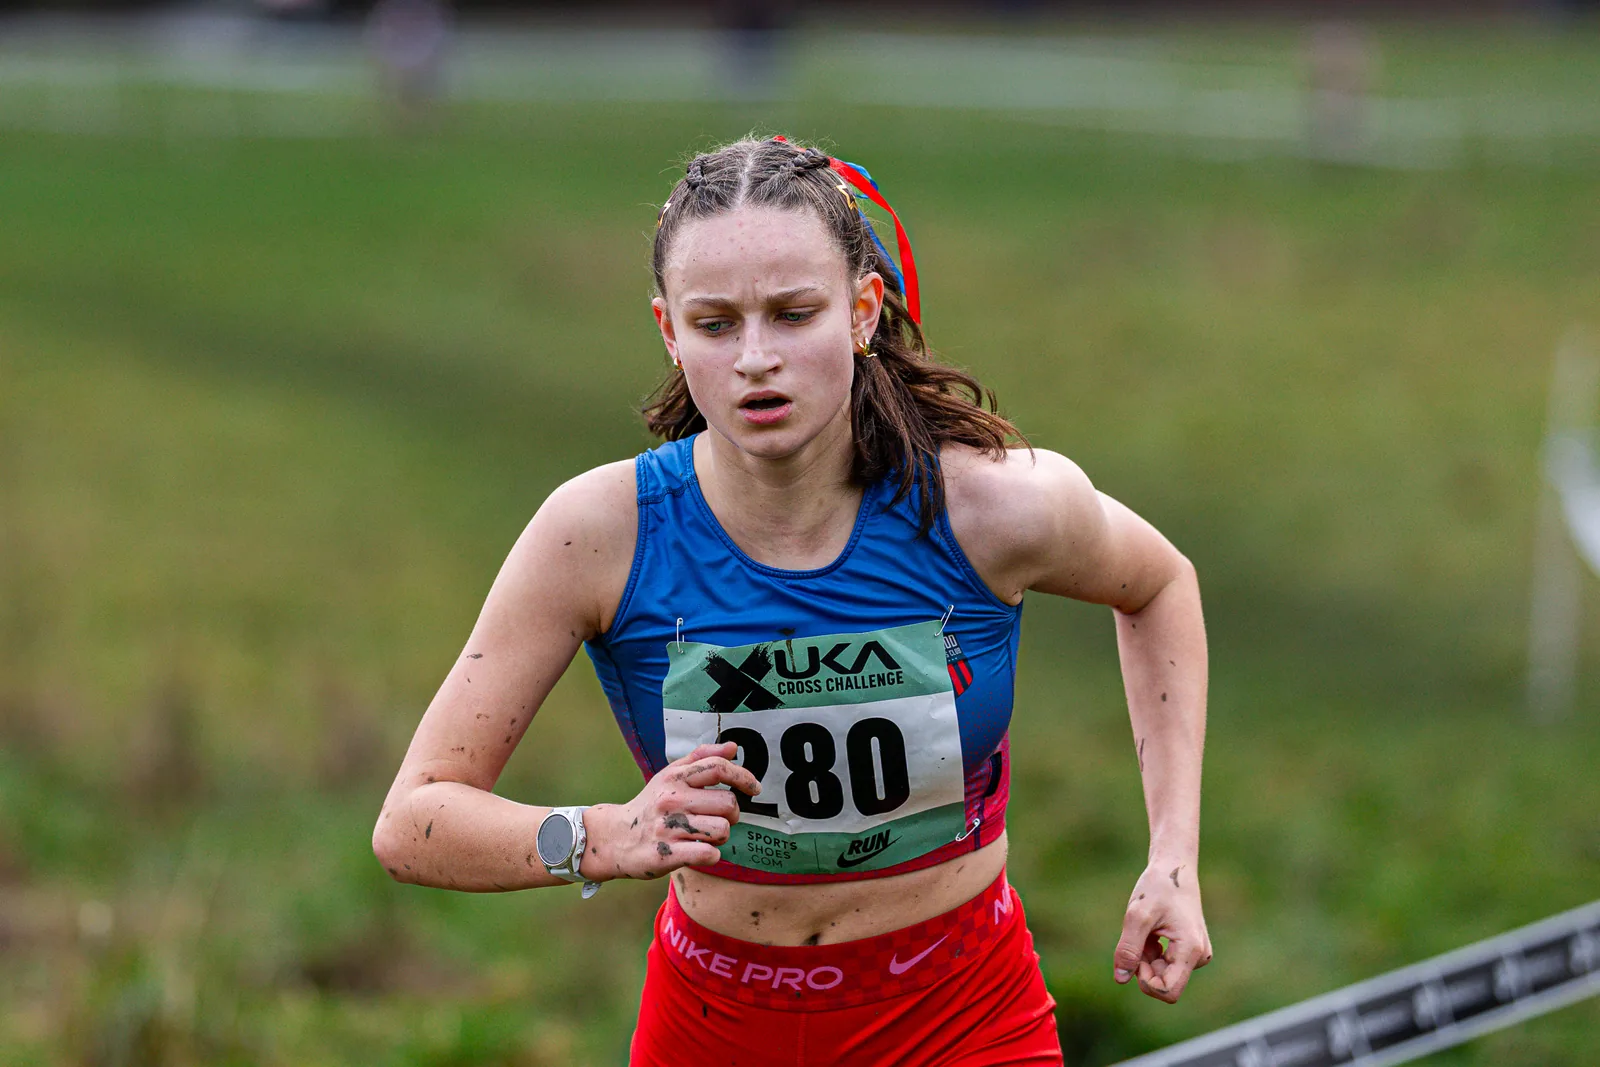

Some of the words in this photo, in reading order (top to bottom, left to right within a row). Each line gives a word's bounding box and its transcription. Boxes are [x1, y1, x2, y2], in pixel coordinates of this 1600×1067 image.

[774, 640, 902, 680] UKA
[777, 679, 822, 696] CROSS
[825, 670, 904, 693] CHALLENGE
[714, 716, 911, 820] 280
[747, 830, 798, 850] SPORTS
[747, 842, 791, 860] SHOES
[847, 829, 891, 856] RUN
[663, 917, 738, 978] NIKE
[740, 962, 844, 991] PRO
